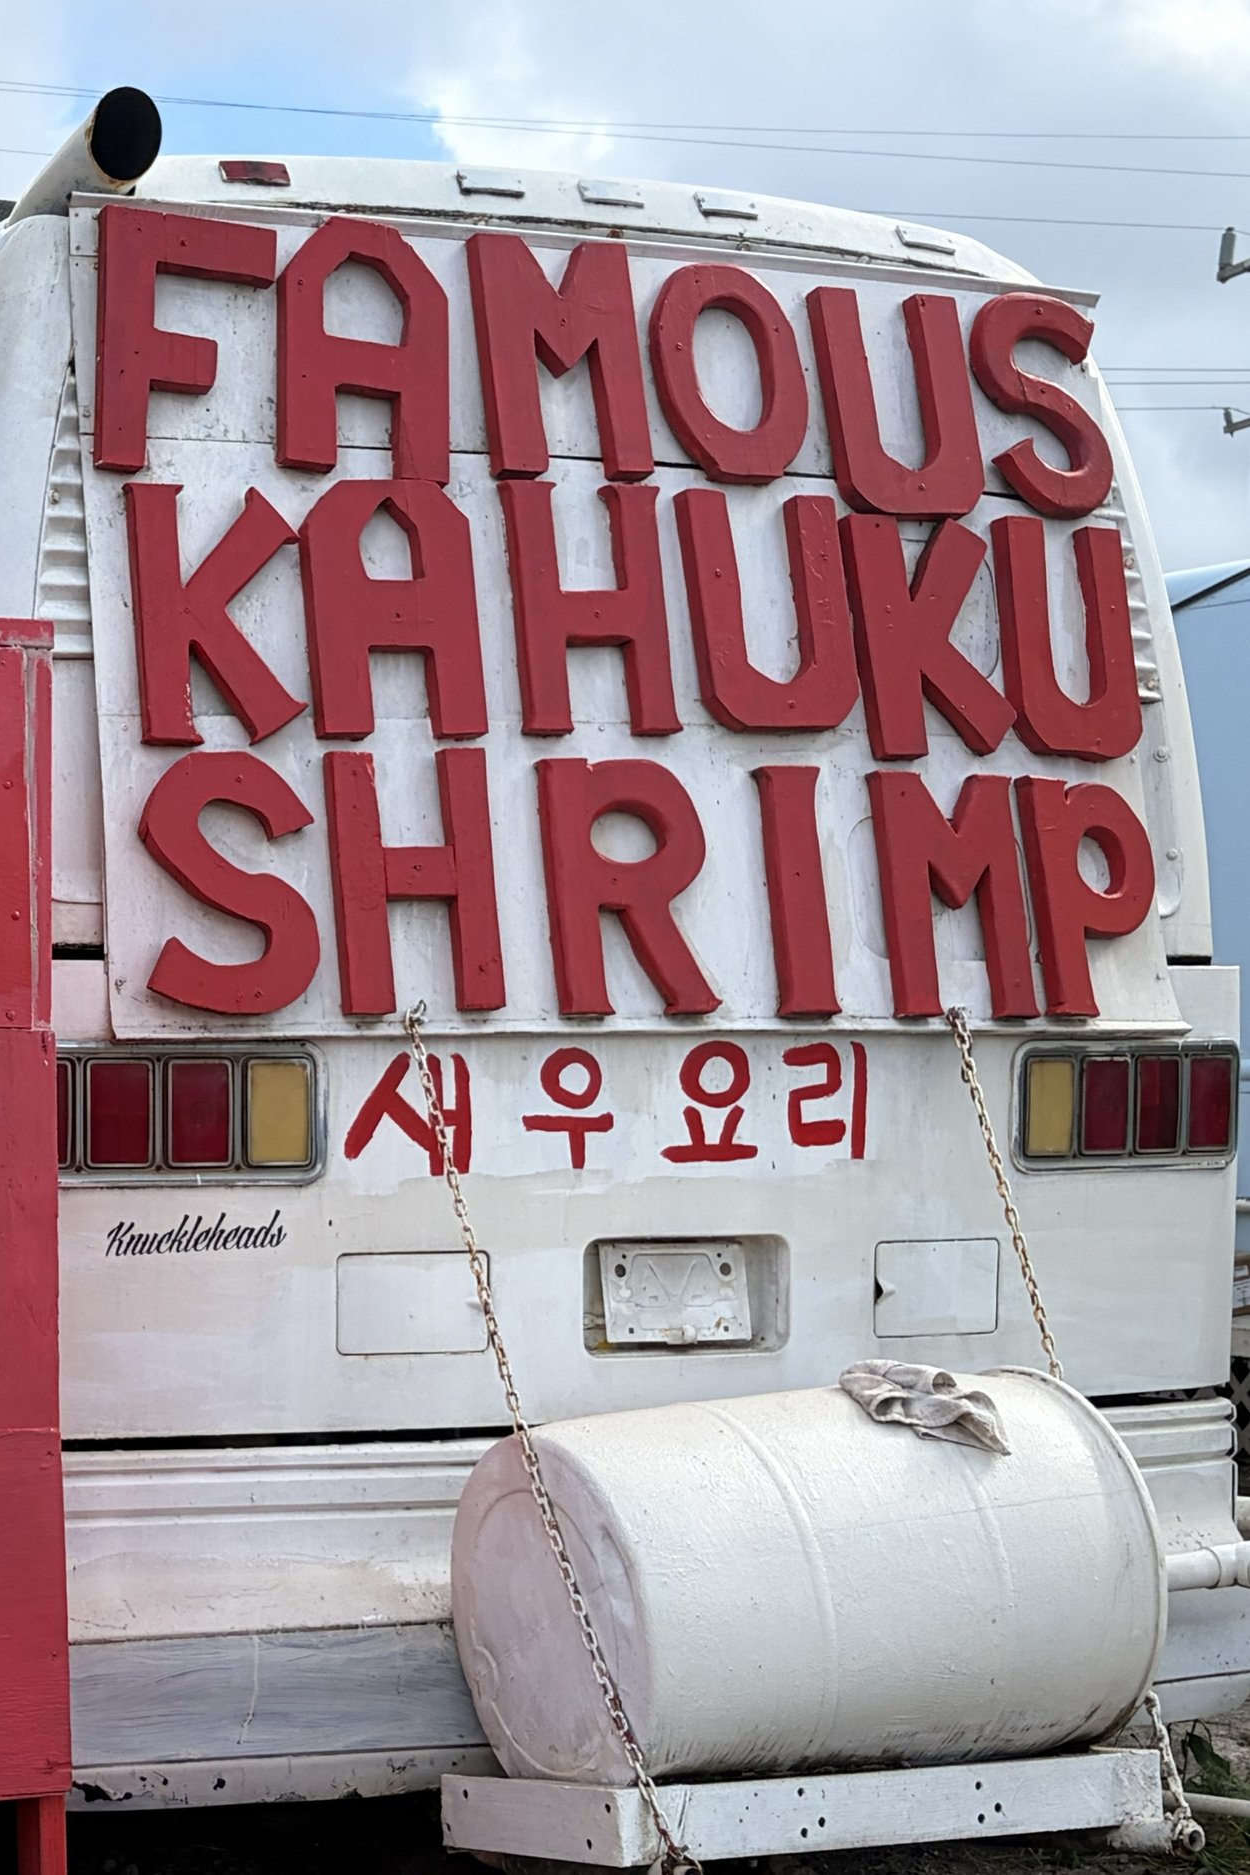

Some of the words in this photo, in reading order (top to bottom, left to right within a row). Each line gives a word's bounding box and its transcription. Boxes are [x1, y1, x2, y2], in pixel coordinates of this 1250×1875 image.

[93, 204, 1114, 520] FAMOUS
[124, 478, 1143, 763] KAHUKU
[139, 747, 1154, 1018] SHRIMP
[105, 1209, 288, 1257] Knuckleheads
